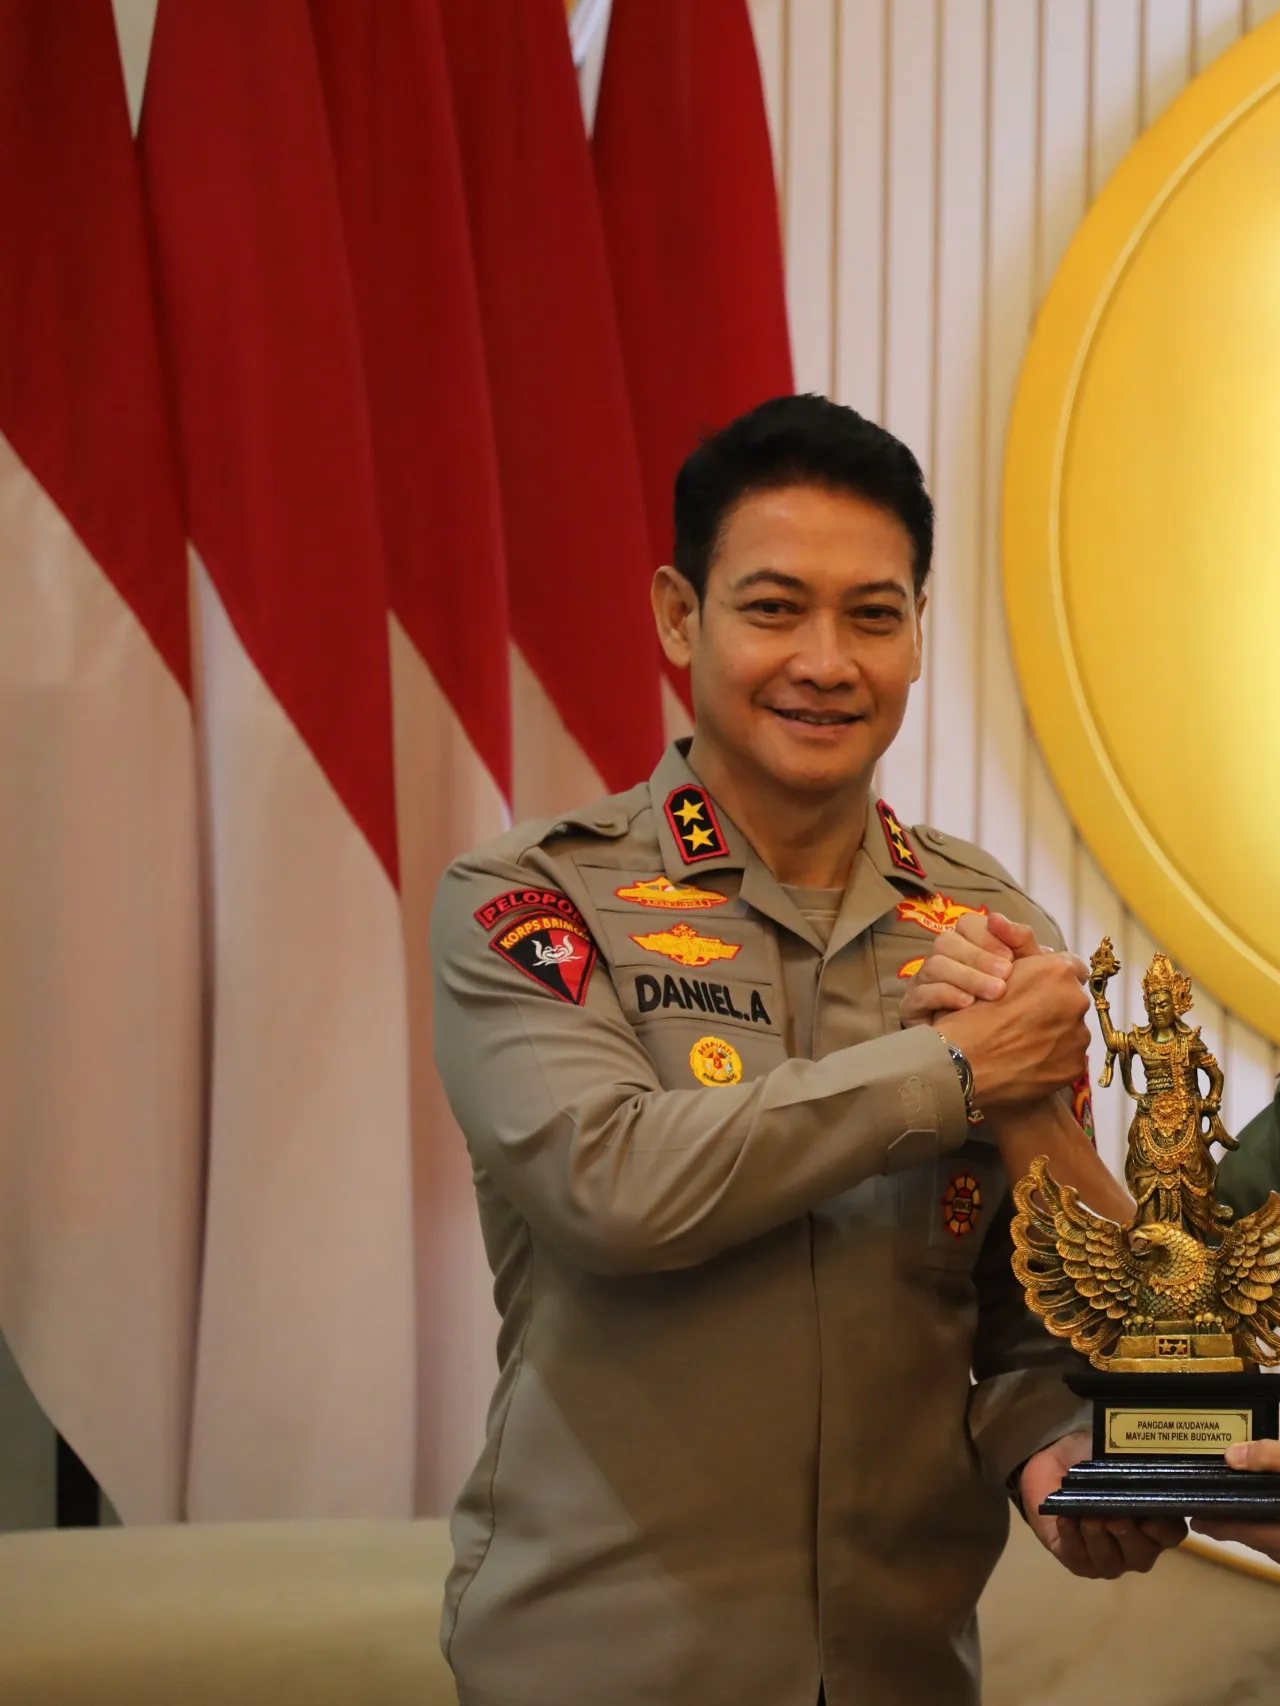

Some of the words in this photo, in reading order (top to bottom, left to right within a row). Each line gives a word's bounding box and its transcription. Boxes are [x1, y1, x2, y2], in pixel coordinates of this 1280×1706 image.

[500, 920, 541, 950] KORPS
[635, 974, 772, 1026] DANIEL.A
[1137, 1421, 1175, 1429] PANGDAM
[1176, 1421, 1220, 1430] IX/UDAYANA
[1125, 1432, 1156, 1441] MAYJEN
[1157, 1432, 1170, 1441] TNI
[1171, 1432, 1189, 1441] PIEK
[1190, 1432, 1232, 1442] BUDYAKTO
